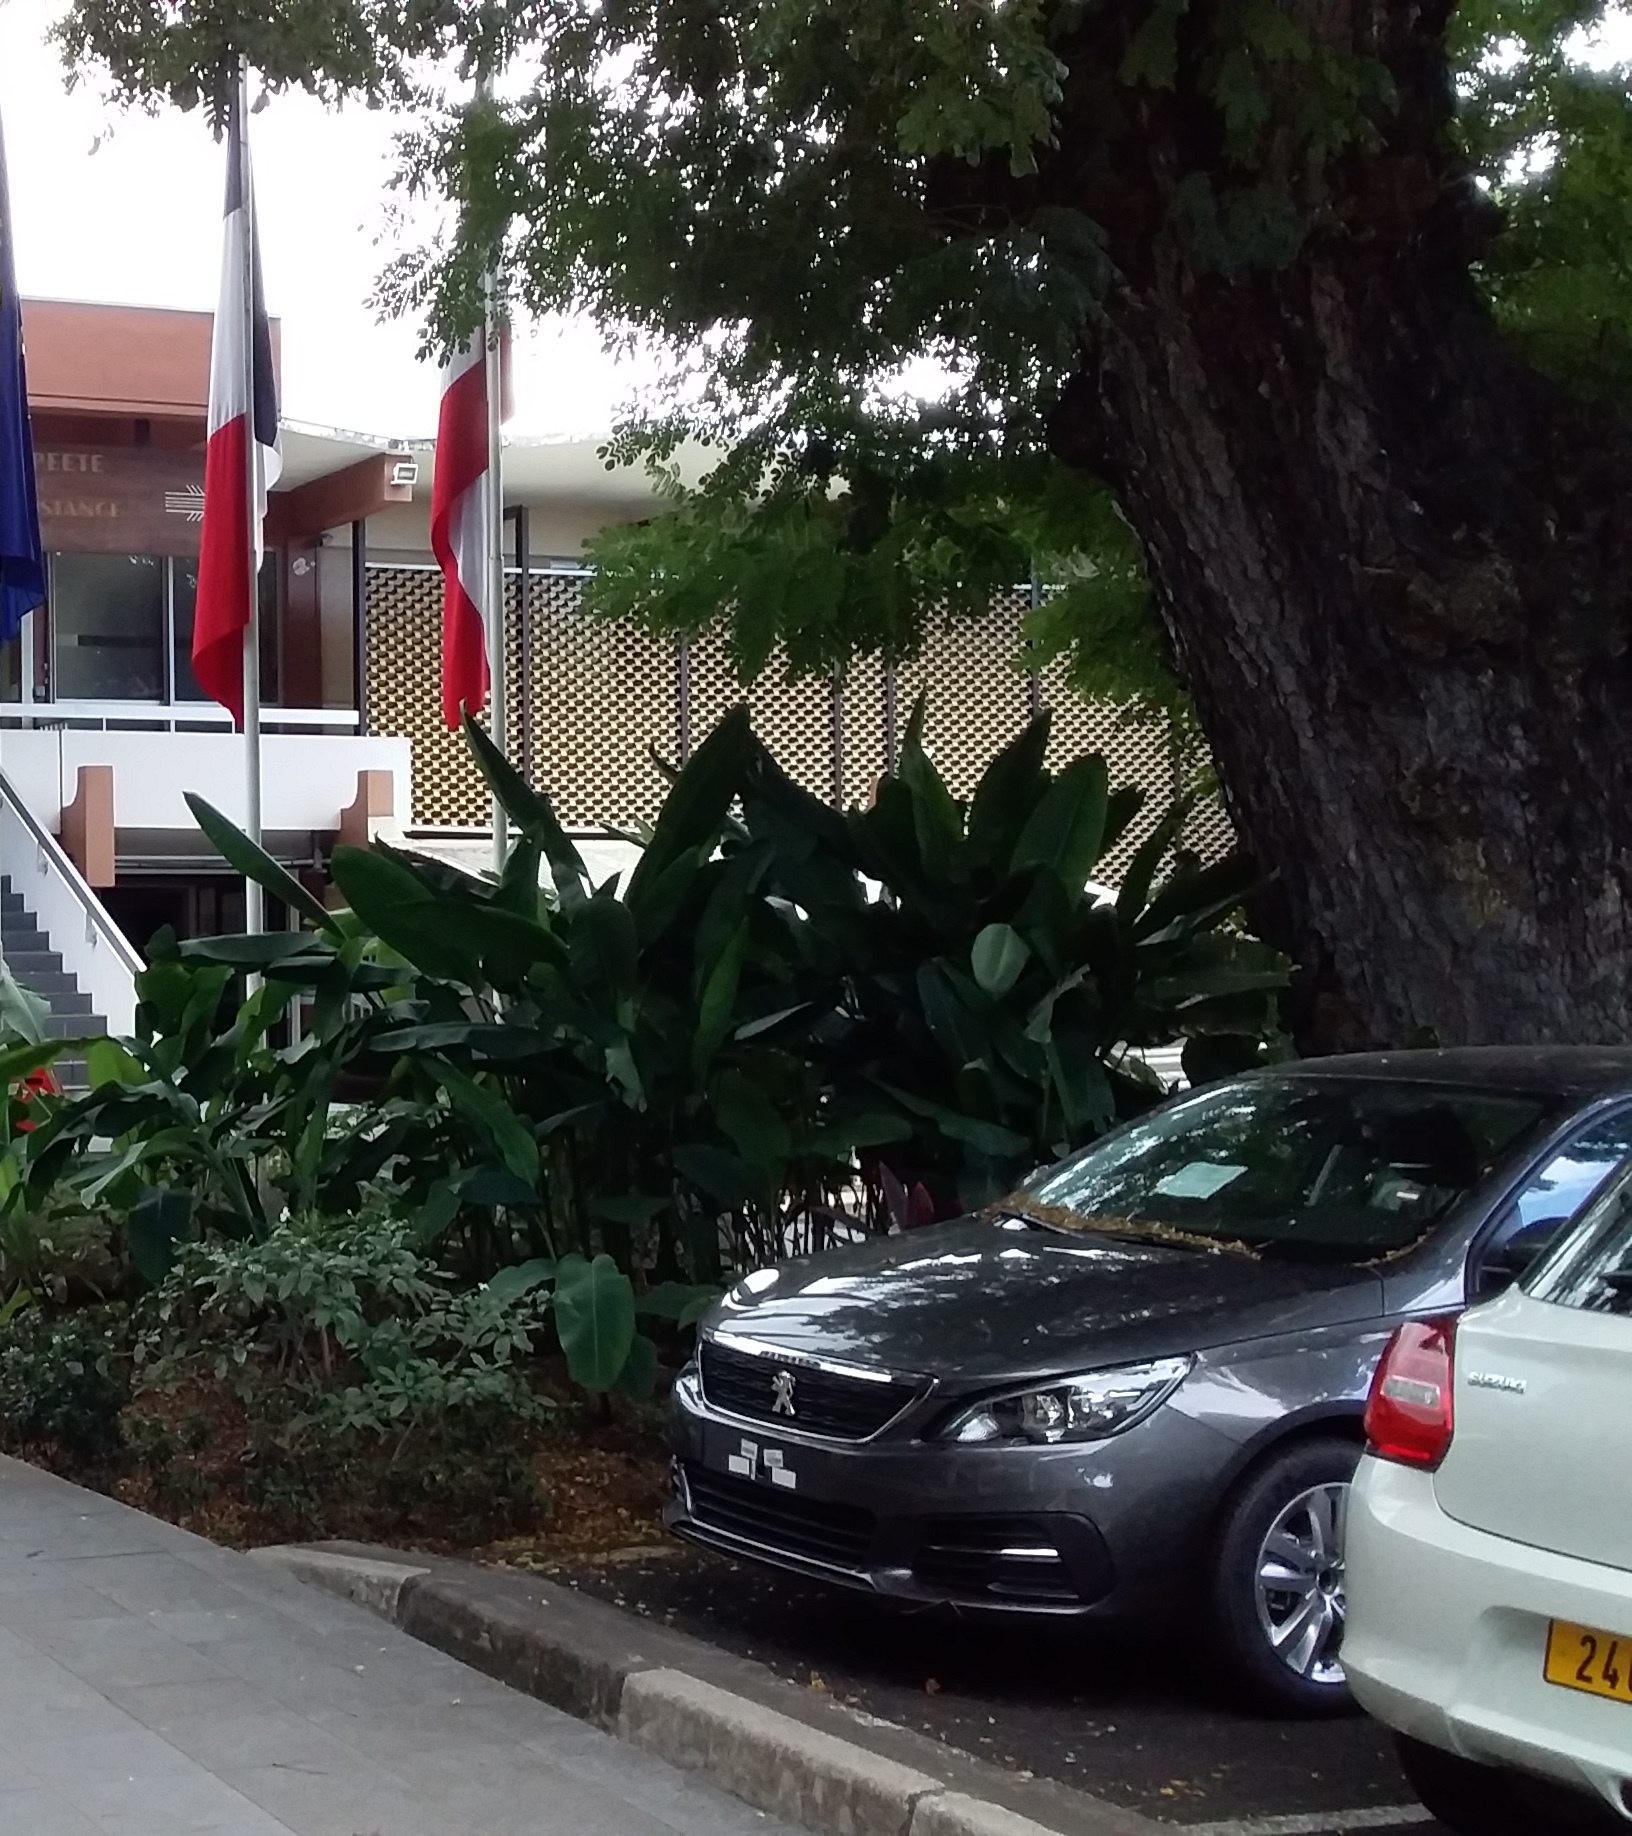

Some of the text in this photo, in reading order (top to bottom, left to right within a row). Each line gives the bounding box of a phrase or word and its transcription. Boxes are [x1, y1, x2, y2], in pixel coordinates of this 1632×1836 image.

[35, 452, 104, 473] PEETE
[40, 500, 120, 518] STANCE
[1468, 1370, 1528, 1394] SUZUKI
[1574, 1633, 1632, 1695] 24
